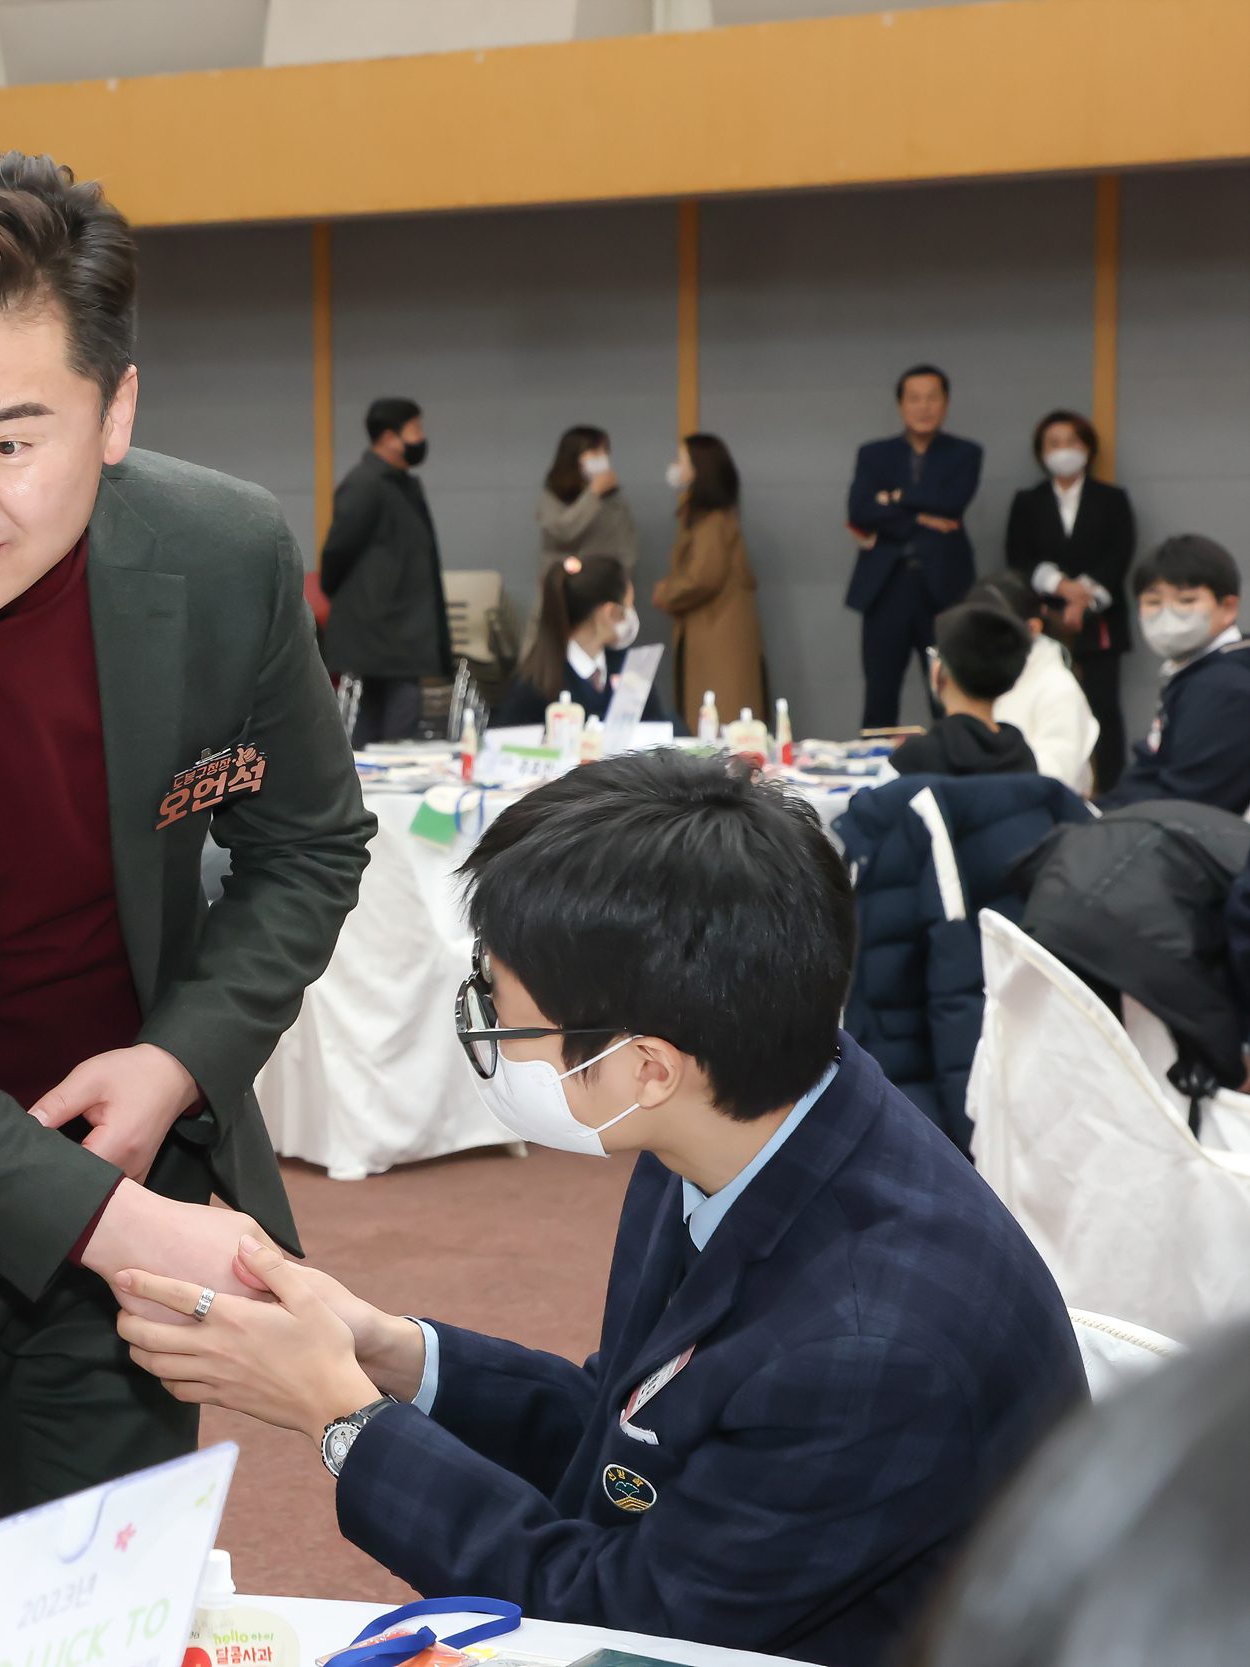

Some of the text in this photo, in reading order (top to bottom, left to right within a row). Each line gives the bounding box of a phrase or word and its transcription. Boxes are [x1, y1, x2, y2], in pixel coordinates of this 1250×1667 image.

[173, 757, 232, 791] 도봉구청장
[155, 760, 266, 831] 오언석
[17, 1572, 98, 1629] 2023년
[125, 1597, 170, 1648] TO
[213, 1629, 249, 1646] hello
[251, 1632, 274, 1642] 아이
[215, 1646, 273, 1665] 달콤사과
